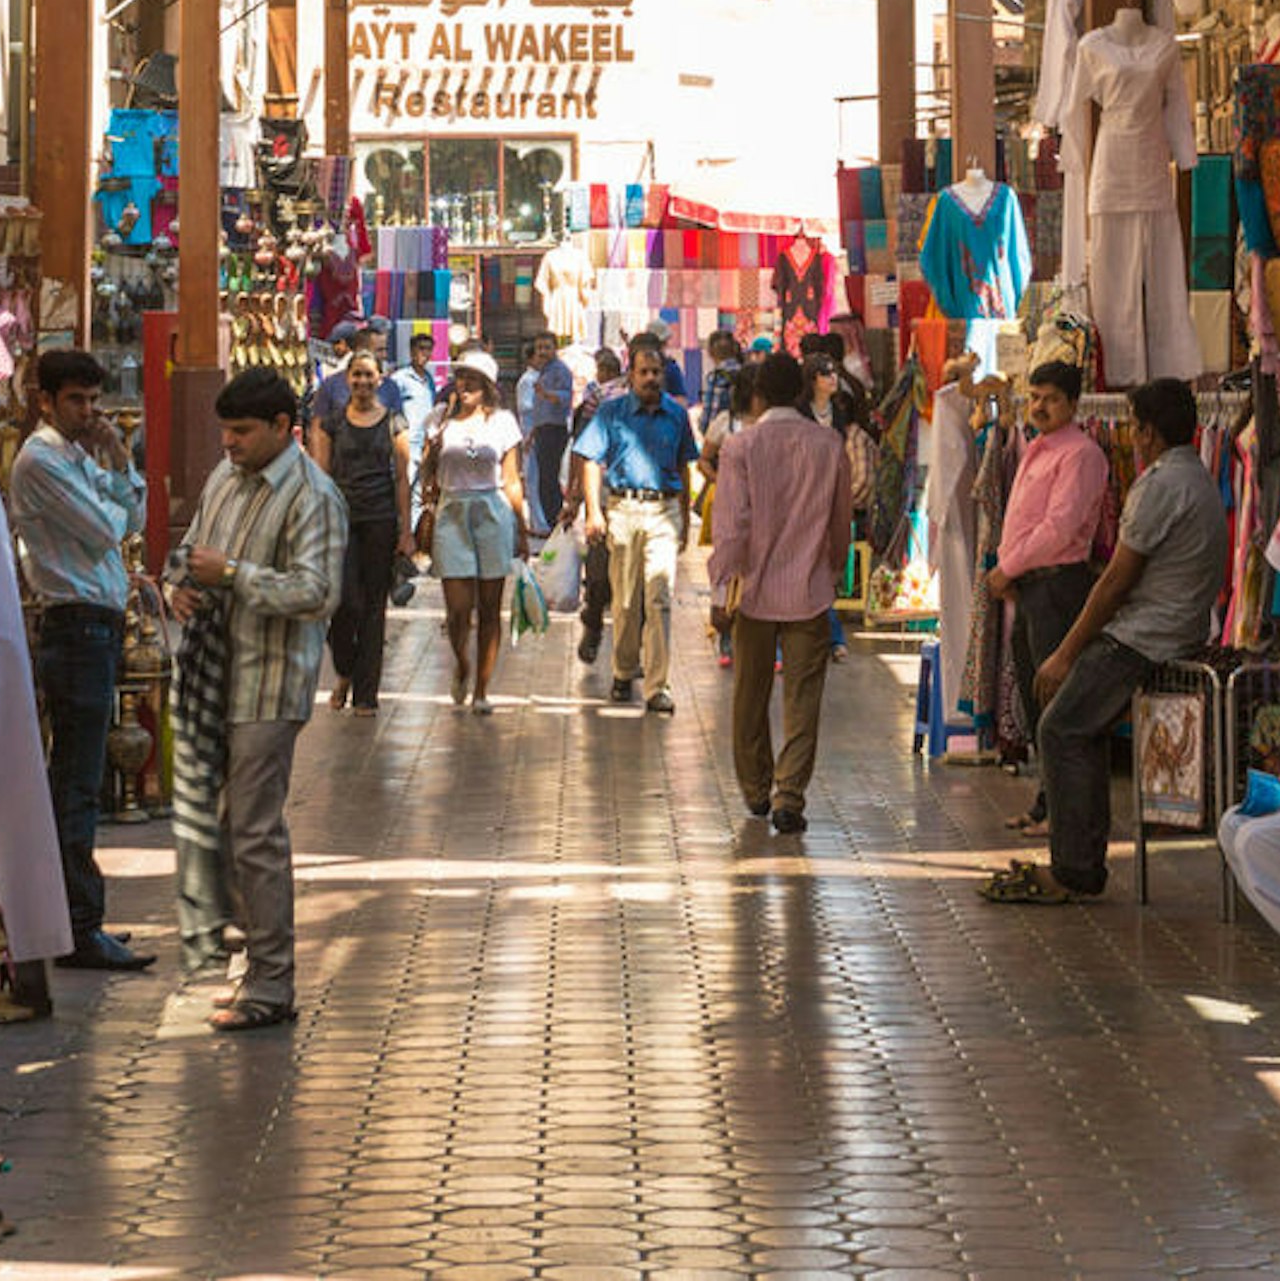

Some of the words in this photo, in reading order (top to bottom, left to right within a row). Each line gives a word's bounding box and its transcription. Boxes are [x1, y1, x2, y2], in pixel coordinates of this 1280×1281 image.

[349, 22, 417, 61] AYT
[428, 23, 473, 61] AL
[483, 23, 635, 63] WAKEEL
[373, 81, 599, 119] Restaurant
